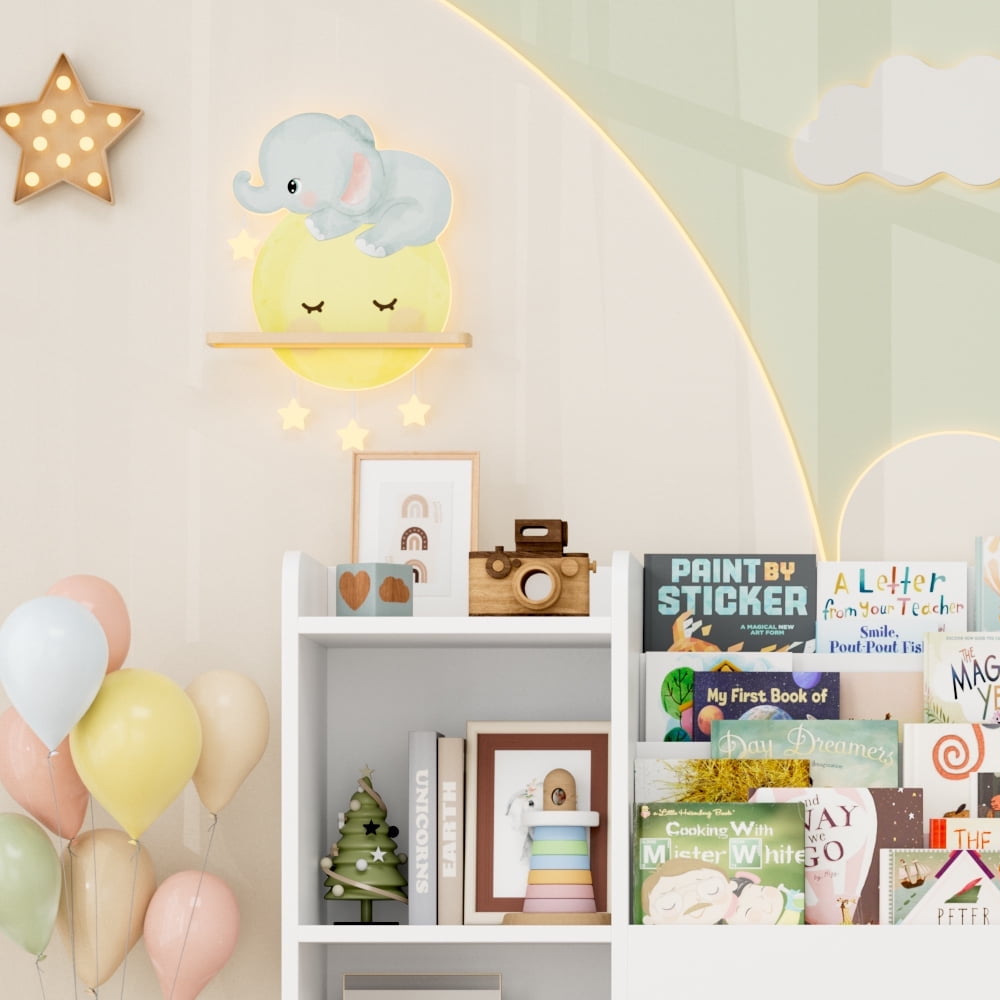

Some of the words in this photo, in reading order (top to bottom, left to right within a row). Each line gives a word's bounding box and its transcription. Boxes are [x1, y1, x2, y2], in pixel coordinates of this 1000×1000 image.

[672, 558, 761, 583] PAINT
[764, 561, 796, 581] BY
[834, 572, 849, 594] A
[859, 566, 946, 594] Letter
[658, 585, 808, 616] STICKER
[822, 598, 857, 620] from
[859, 601, 895, 618] your
[897, 595, 964, 616] Teacher
[860, 624, 899, 639] Smile,
[959, 647, 975, 662] THE
[707, 688, 727, 706] My
[731, 688, 767, 703] First
[770, 687, 808, 703] Book
[811, 688, 828, 703] of
[718, 729, 772, 759] Day
[783, 722, 895, 769] Dreamers
[415, 768, 429, 894] UNICORNS
[442, 781, 457, 878] EARTH
[665, 821, 728, 839] Cooking
[730, 820, 774, 836] With
